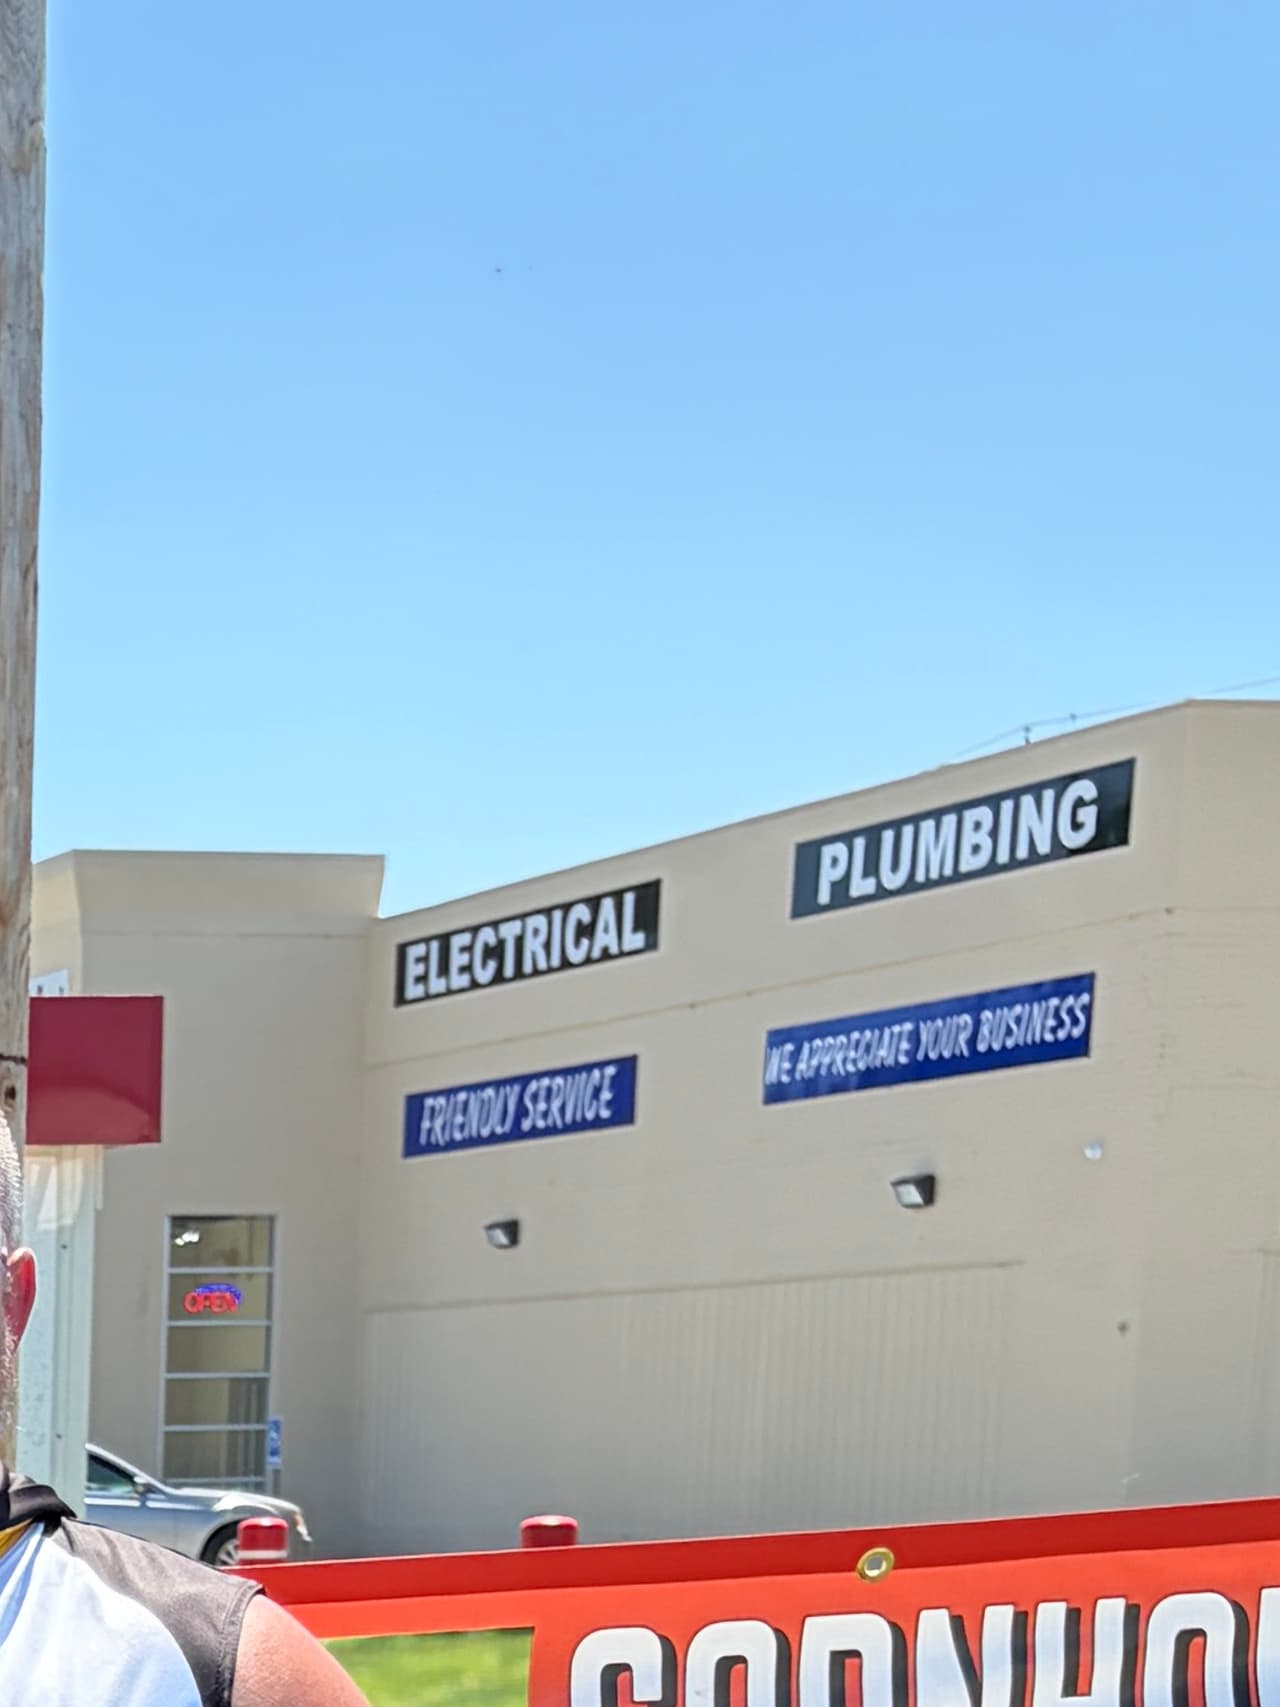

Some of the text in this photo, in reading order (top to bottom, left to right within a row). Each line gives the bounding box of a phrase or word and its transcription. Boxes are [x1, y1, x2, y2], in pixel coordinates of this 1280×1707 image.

[817, 779, 1099, 906] PLUMBING
[403, 890, 646, 1001] ELECTRICAL
[765, 992, 1090, 1086] WE APPRECIATE YOUR BUSINESS
[419, 1065, 620, 1147] FRIENDLY SERVICE
[183, 1291, 239, 1314] OPEN
